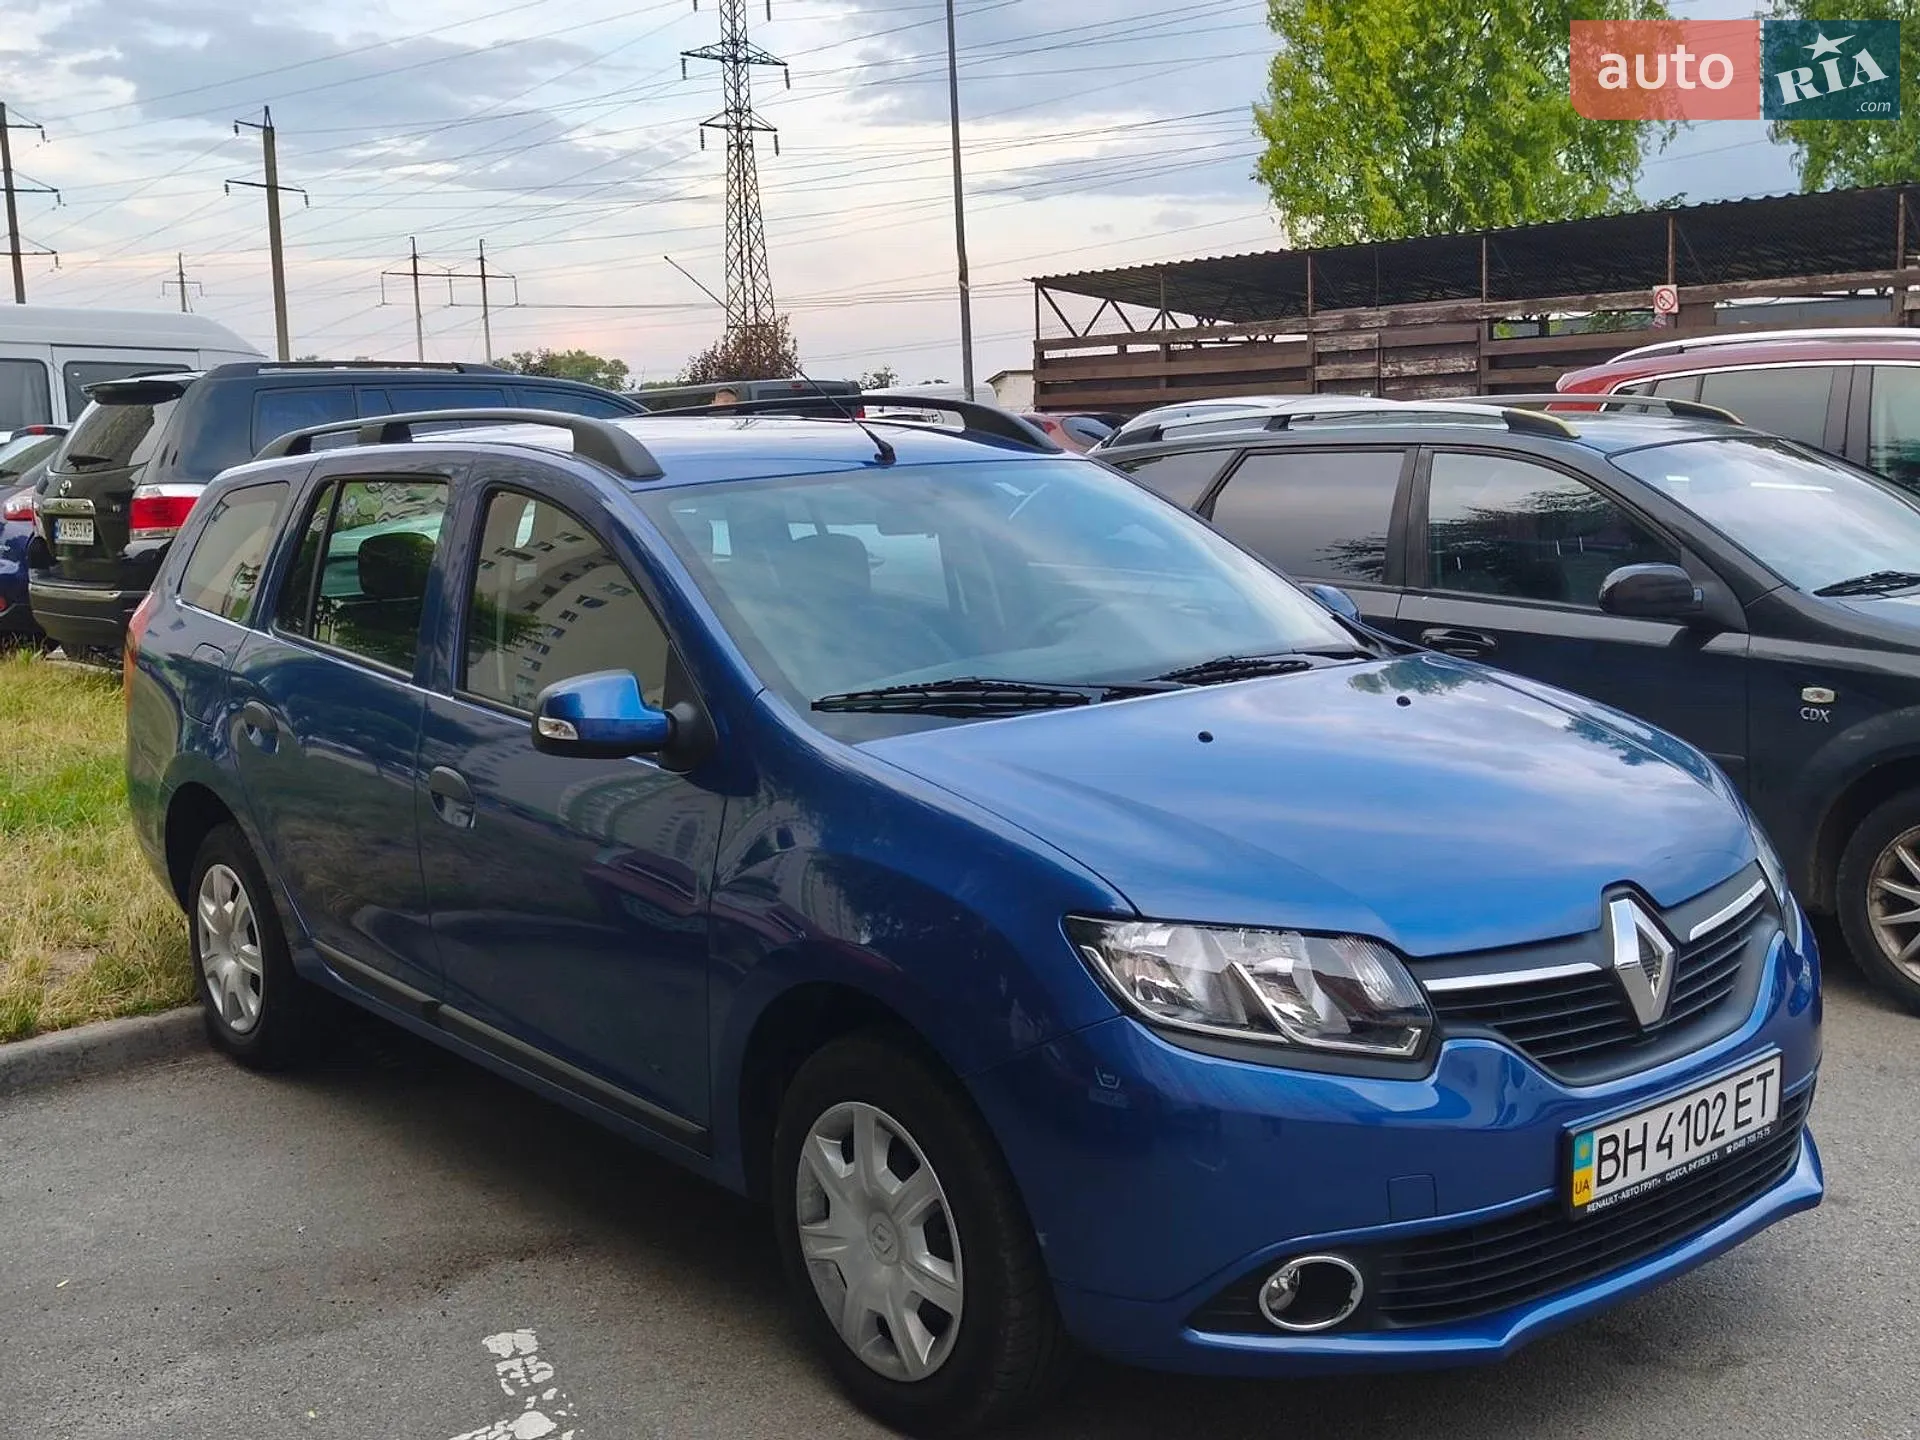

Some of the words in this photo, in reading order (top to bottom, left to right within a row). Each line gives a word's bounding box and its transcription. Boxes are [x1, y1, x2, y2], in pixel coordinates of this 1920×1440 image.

[1800, 706, 1830, 723] CDX
[1596, 1122, 1648, 1188] BH
[1656, 1091, 1727, 1160] 4102
[1734, 1068, 1775, 1131] ET
[1575, 1177, 1591, 1195] UA
